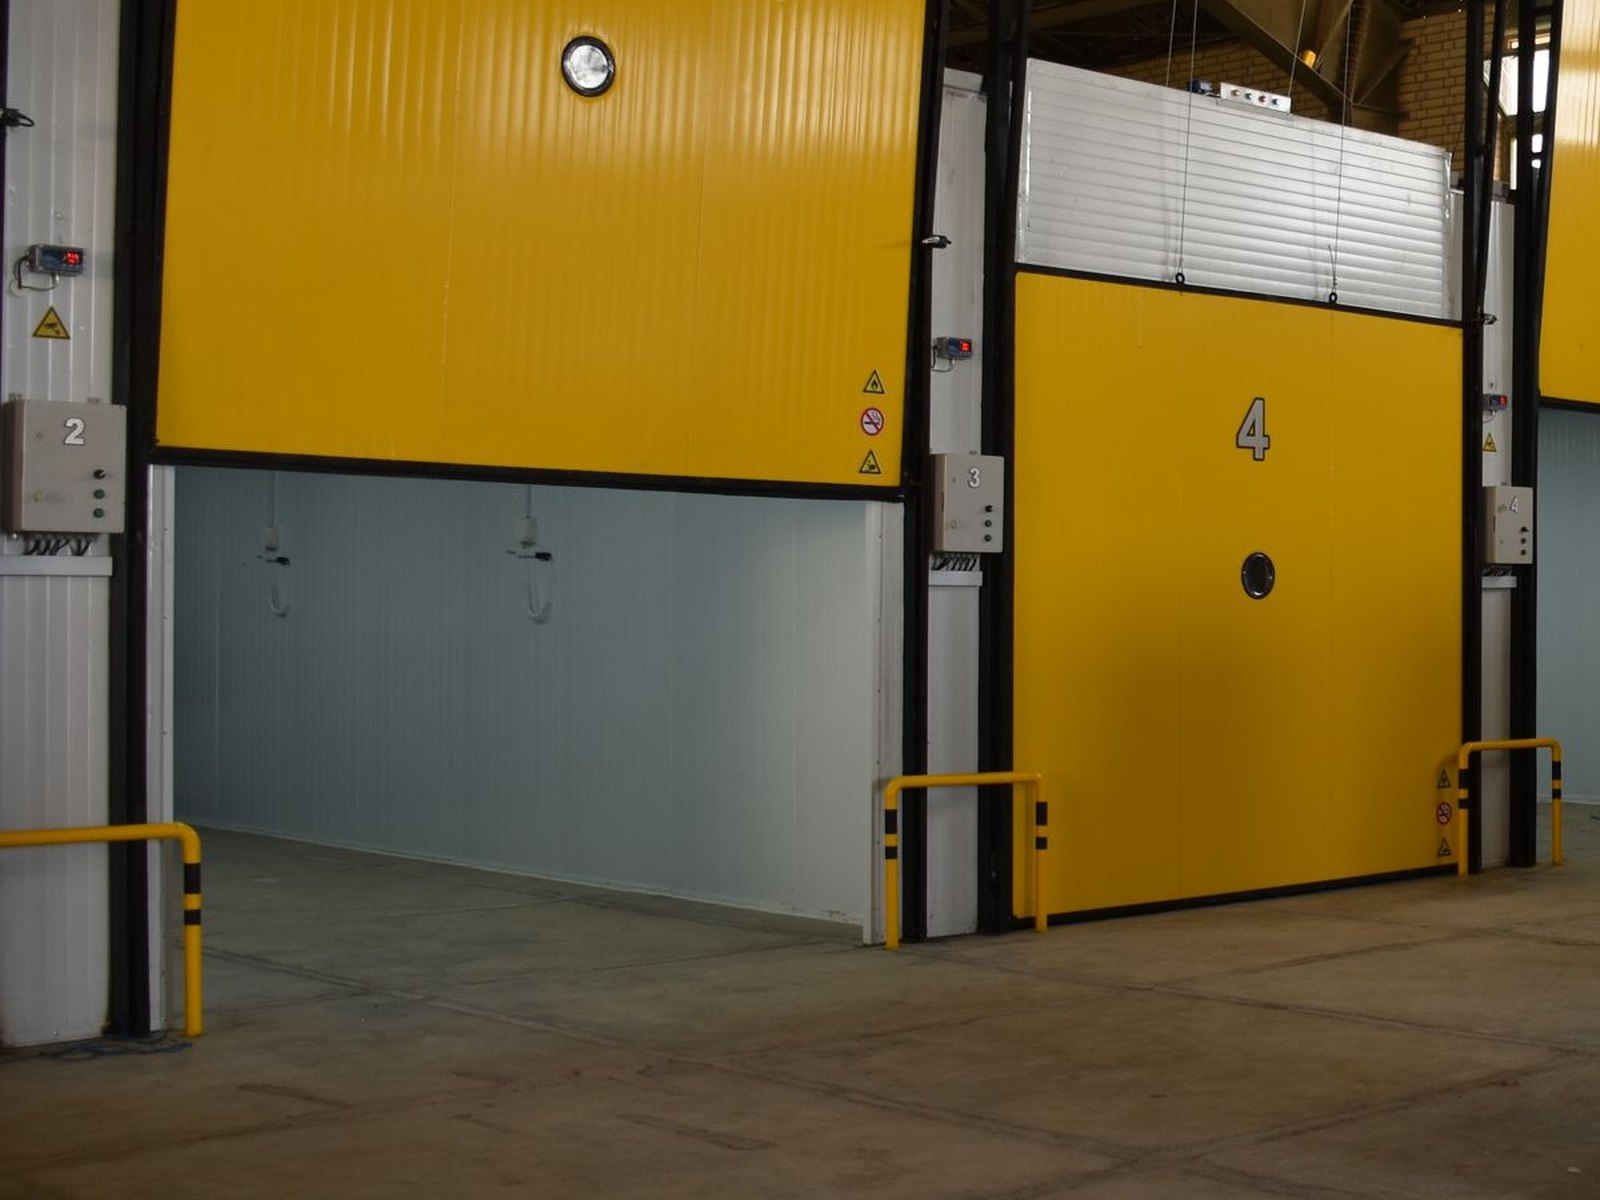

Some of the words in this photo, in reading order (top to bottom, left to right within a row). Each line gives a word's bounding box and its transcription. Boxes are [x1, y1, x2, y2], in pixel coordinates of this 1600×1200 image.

[64, 417, 85, 445] 2
[1236, 397, 1270, 461] 4
[968, 467, 980, 488] 3
[1510, 496, 1519, 513] 4
